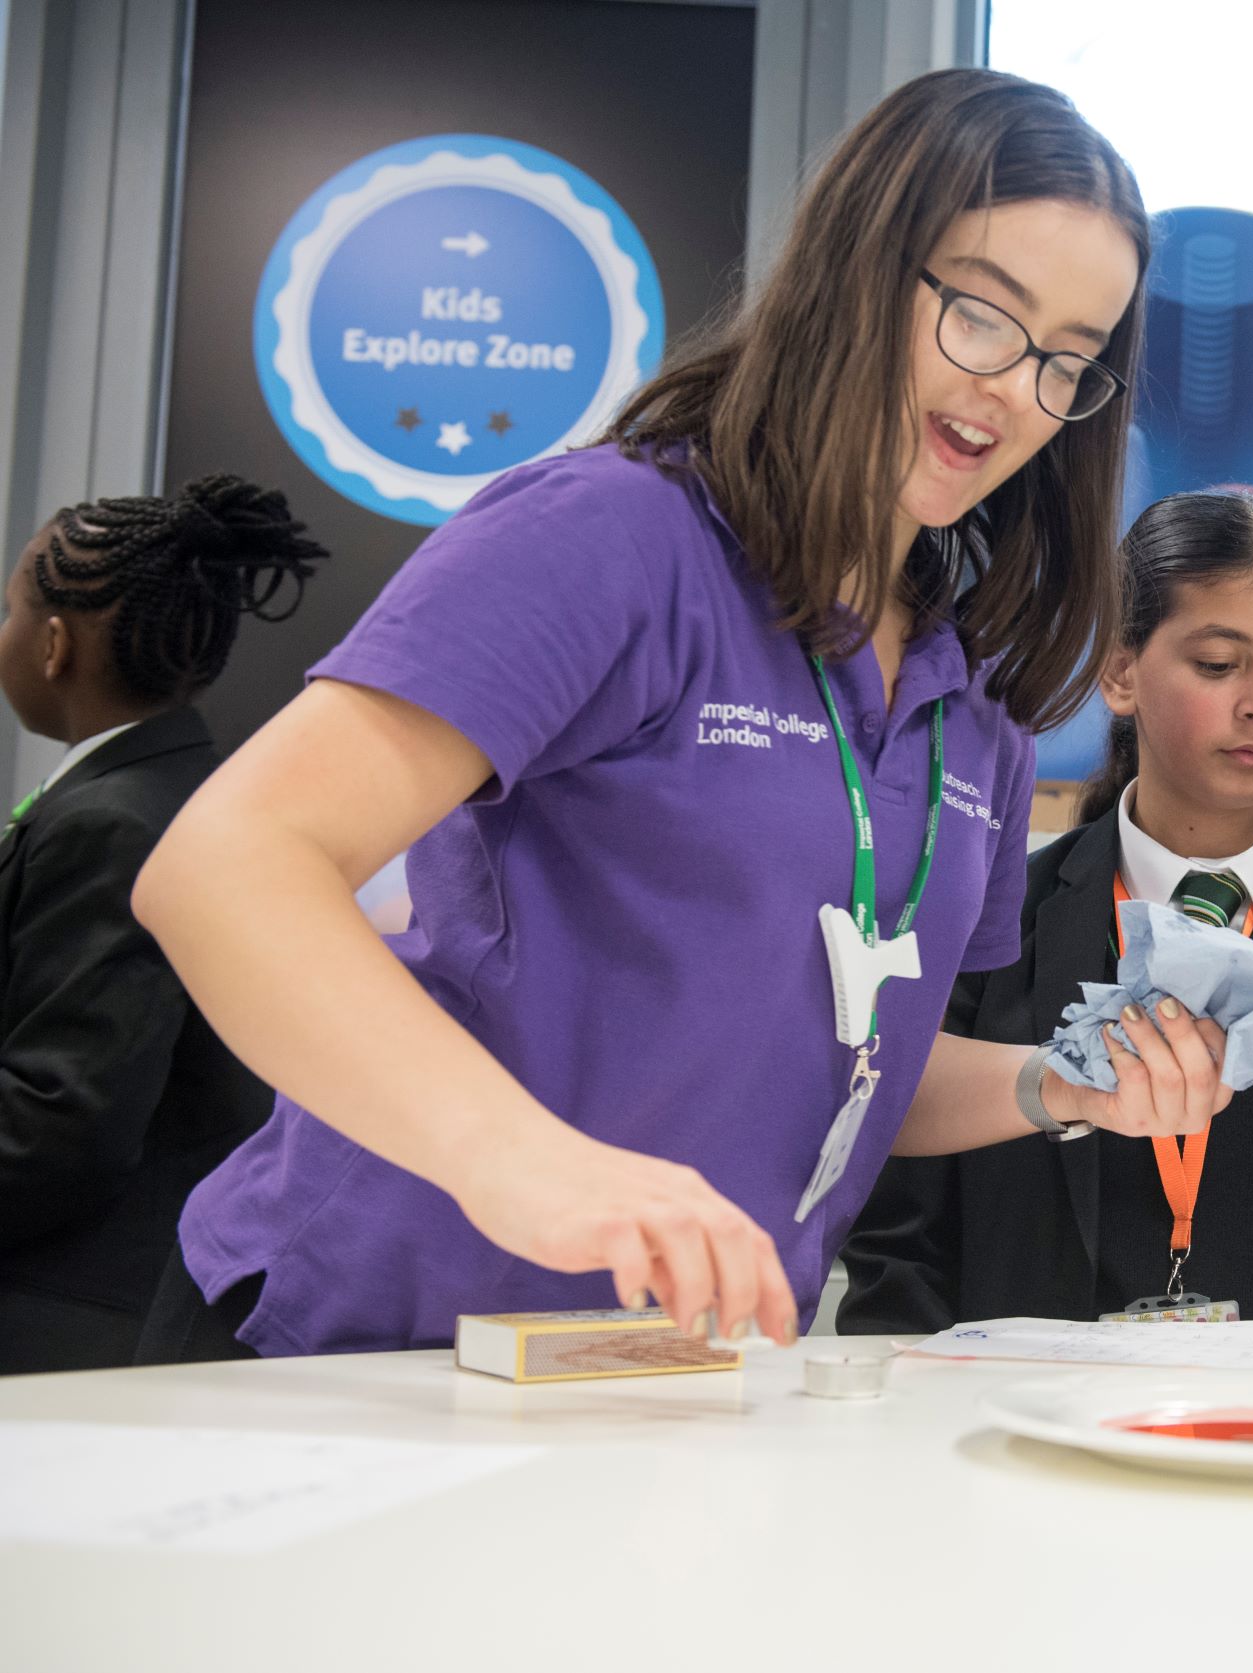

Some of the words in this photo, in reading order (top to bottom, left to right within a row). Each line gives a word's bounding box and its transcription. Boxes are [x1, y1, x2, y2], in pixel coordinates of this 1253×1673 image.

[421, 287, 503, 323] Kids
[342, 328, 481, 372] Explore
[484, 334, 576, 372] Zone
[697, 722, 771, 749] London
